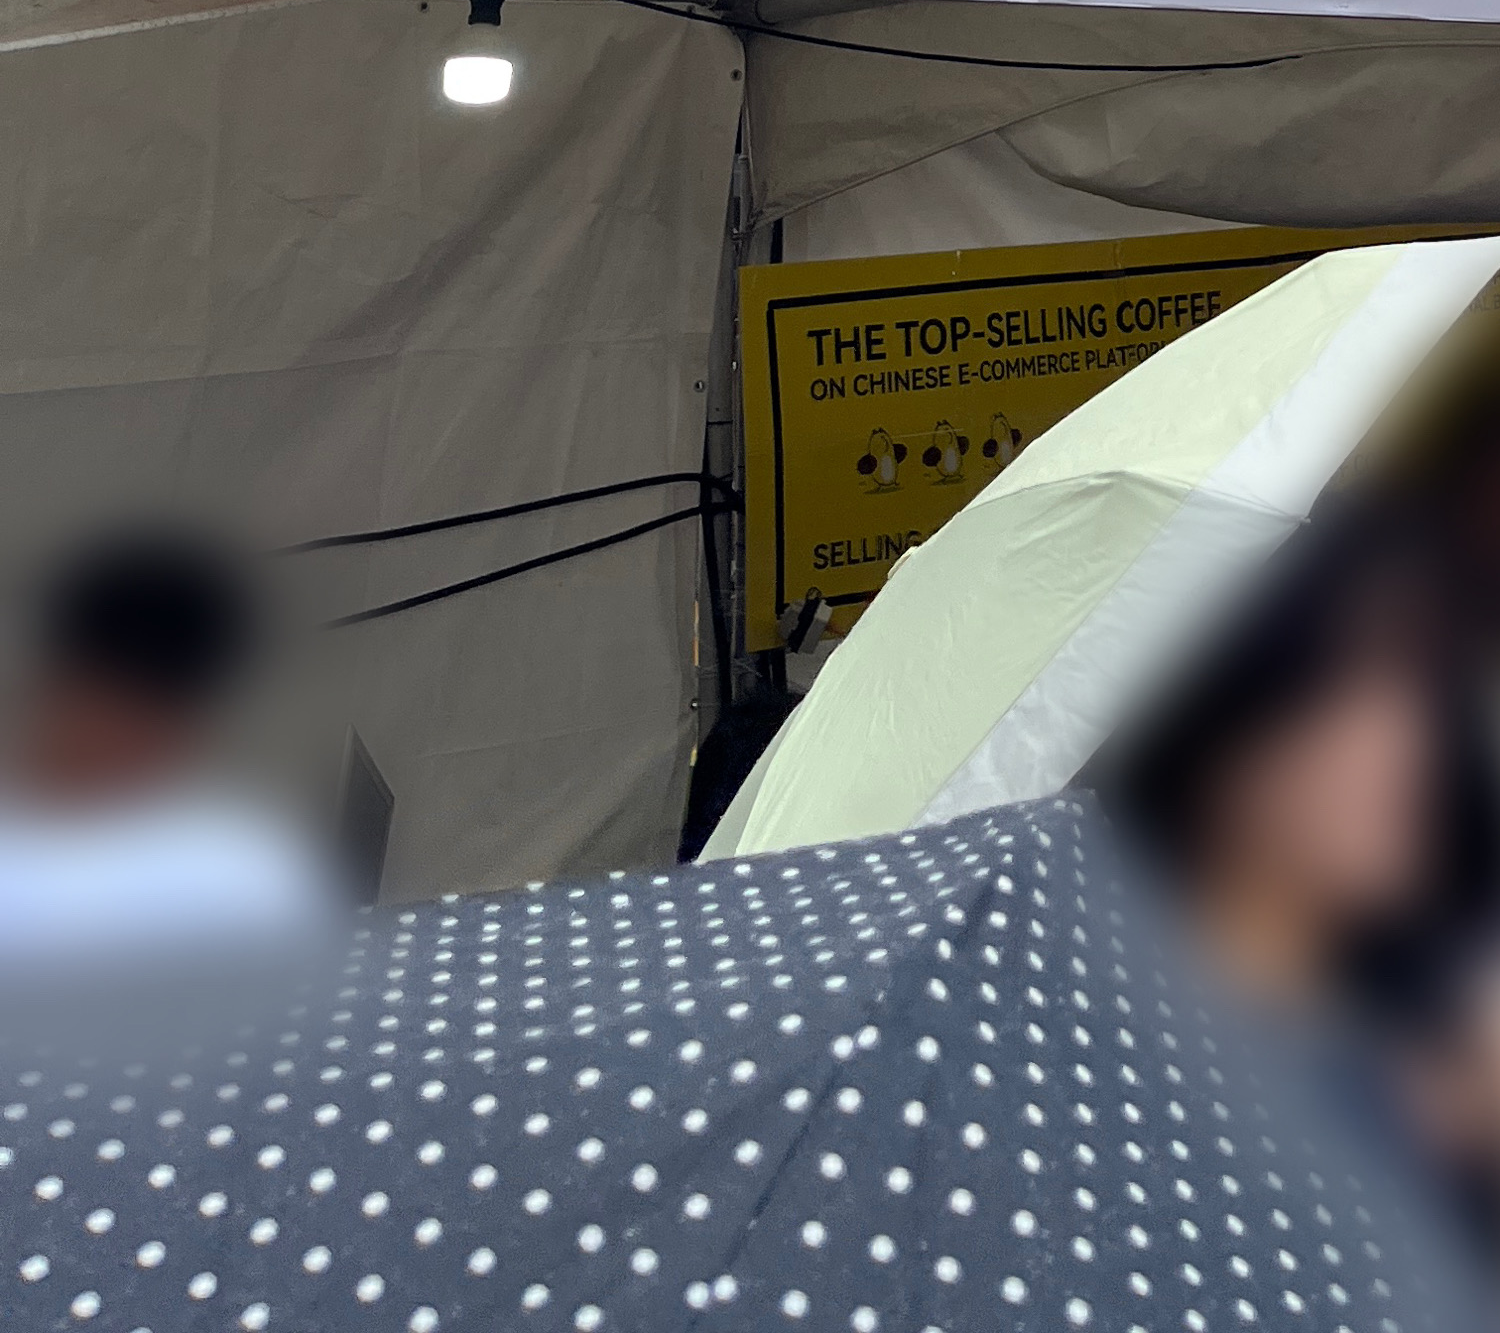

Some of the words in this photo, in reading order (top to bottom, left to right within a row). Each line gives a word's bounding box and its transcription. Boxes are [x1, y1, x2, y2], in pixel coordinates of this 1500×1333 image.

[807, 323, 888, 367] THE
[895, 303, 1106, 358] TOP-SELLING
[1115, 290, 1222, 335] COFFEE
[809, 377, 847, 401] ON
[853, 363, 952, 397] CHINESE
[958, 349, 1081, 387] E-COMMERCE
